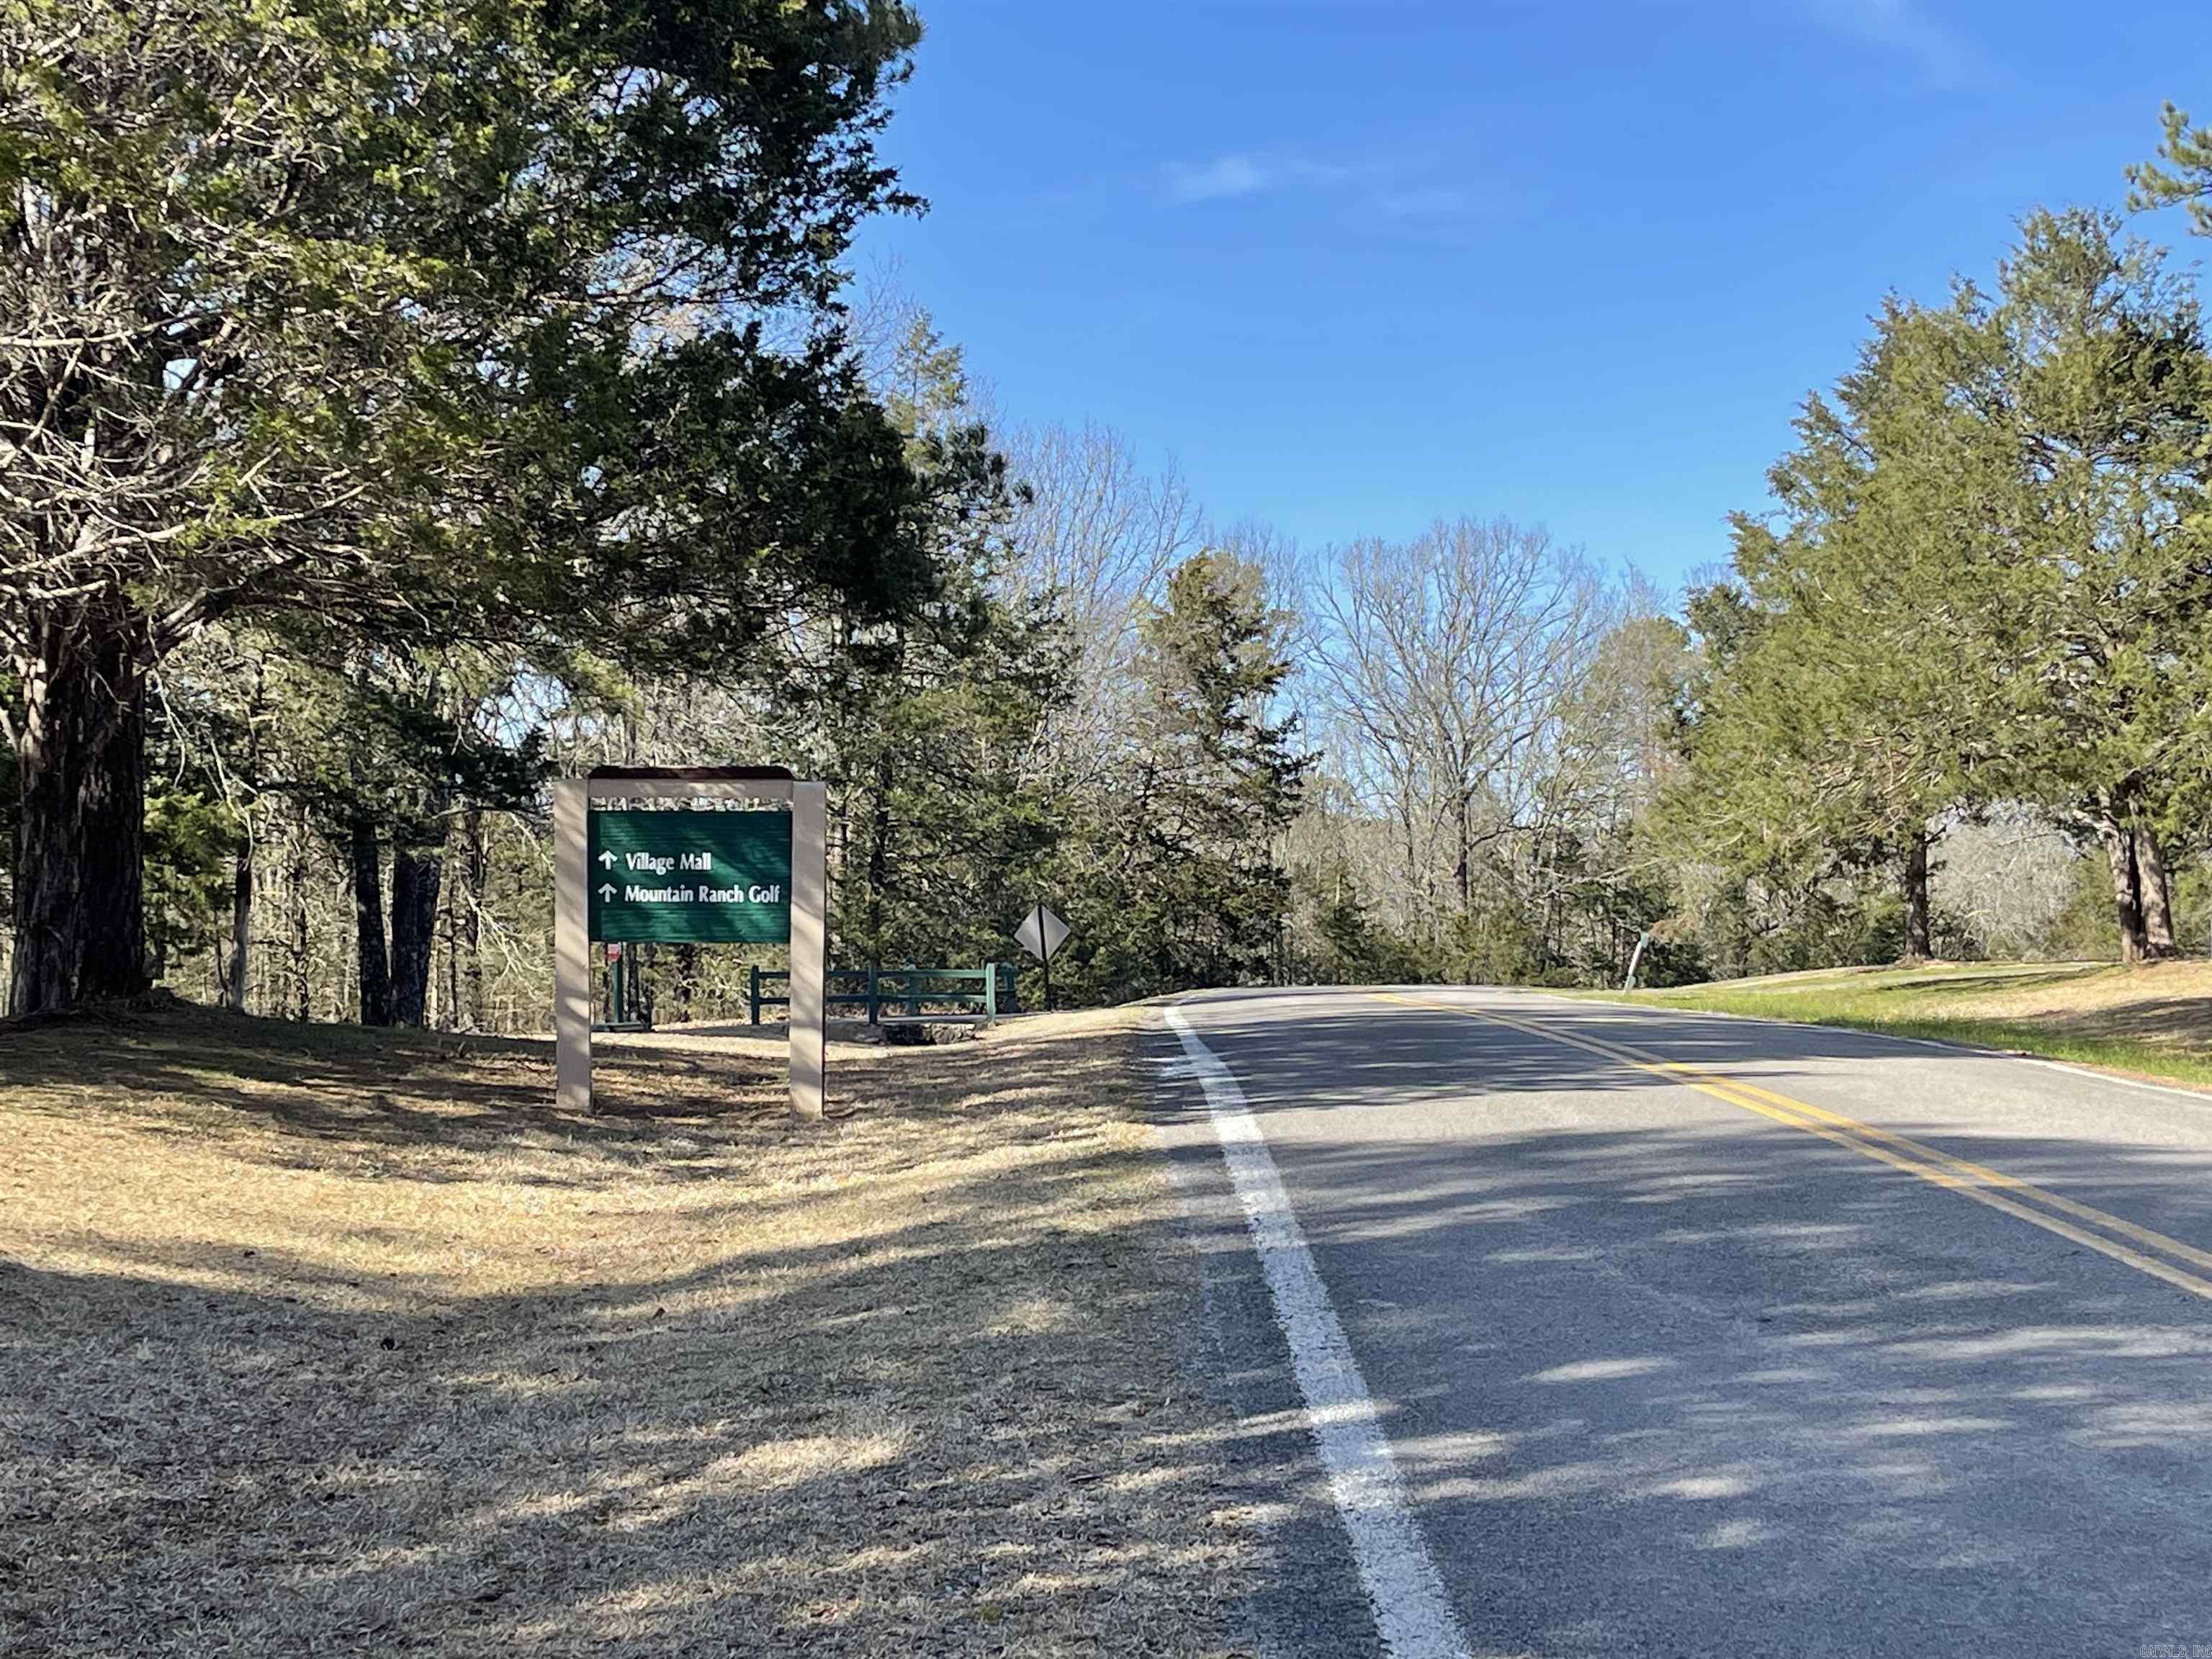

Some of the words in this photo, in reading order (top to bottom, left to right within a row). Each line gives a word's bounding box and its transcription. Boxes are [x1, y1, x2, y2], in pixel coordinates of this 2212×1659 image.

[625, 852, 675, 876] Village
[679, 853, 712, 871] Mall
[624, 884, 694, 902] Mountain
[698, 884, 745, 903] Ranch
[748, 884, 781, 903] Golf
